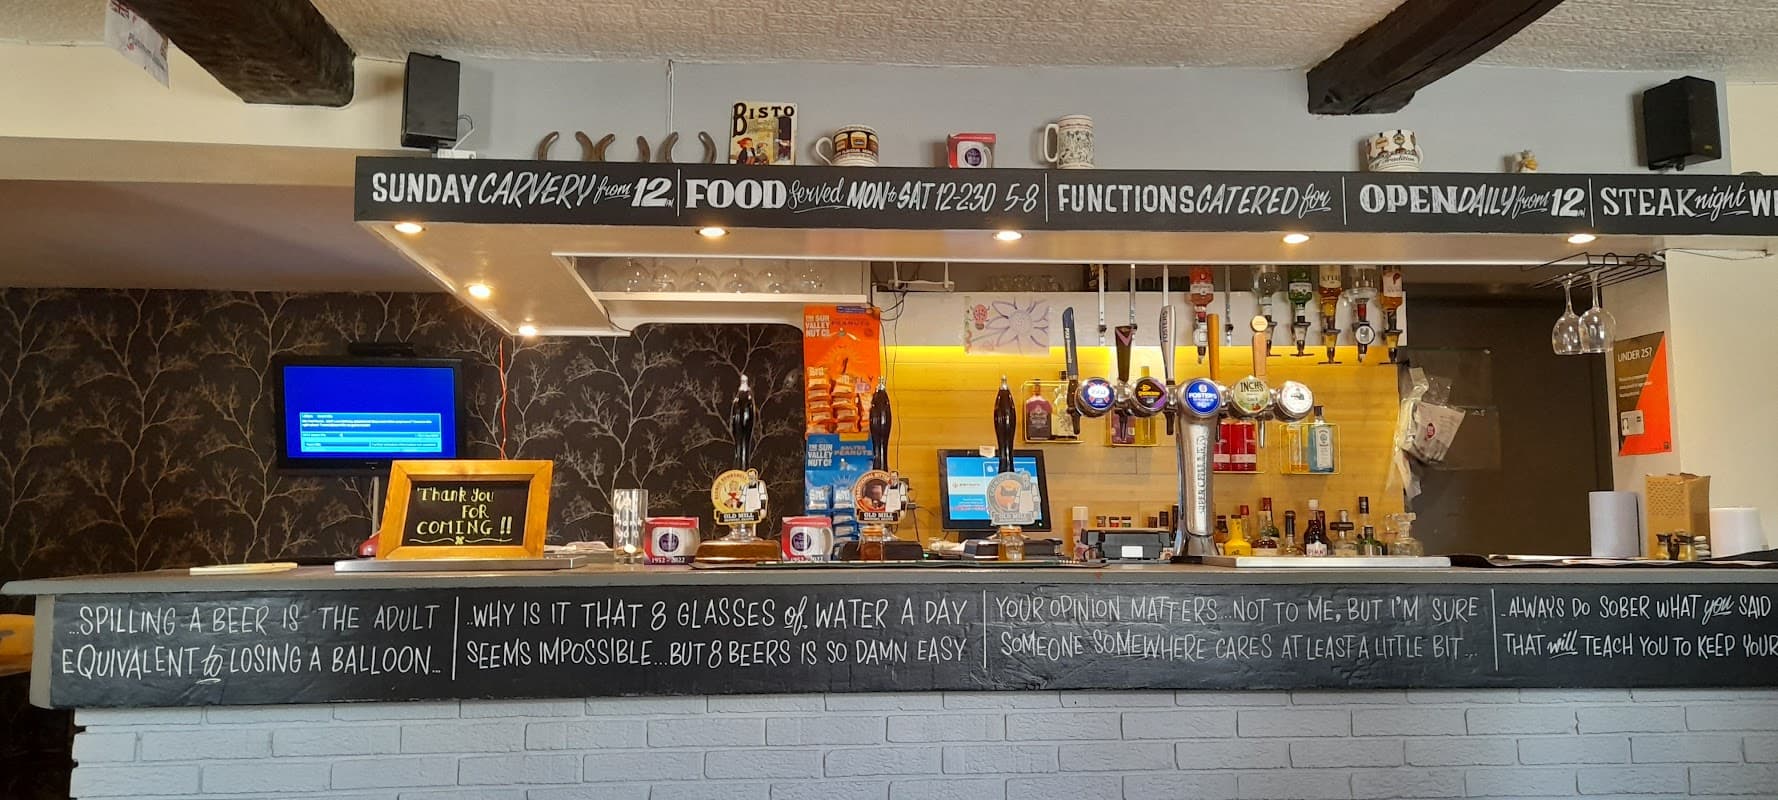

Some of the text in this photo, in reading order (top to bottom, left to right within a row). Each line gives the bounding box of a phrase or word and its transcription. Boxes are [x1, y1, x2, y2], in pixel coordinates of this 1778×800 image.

[732, 102, 795, 137] BISTO
[372, 172, 478, 204] SUNDAY
[476, 170, 597, 209] CARVERY
[592, 175, 632, 205] from
[631, 177, 672, 207] 12
[685, 178, 787, 210] FOOD
[846, 180, 889, 211] MON
[887, 187, 899, 204] to
[898, 181, 936, 210] SAT
[1004, 183, 1040, 213] 5-8
[1057, 183, 1332, 219] FUNCTIONS CATERED for
[1359, 184, 1459, 215] OPEN
[1457, 182, 1517, 217] DAILY
[1511, 185, 1551, 220] from
[1550, 187, 1585, 217] 12
[1600, 187, 1697, 218] STEAK
[1694, 181, 1750, 222] night
[1617, 350, 1640, 362] UNDER
[807, 451, 833, 459] VALLEY
[807, 459, 823, 467] NUT
[818, 443, 833, 451] SUN
[417, 487, 467, 503] Thank
[416, 516, 513, 535] COMING !!
[461, 504, 490, 520] FOR
[189, 606, 202, 633] A
[212, 606, 270, 636] BEER
[282, 604, 299, 632] IS
[319, 605, 360, 632] THE
[374, 604, 440, 634] ADULT
[523, 601, 541, 626] IS
[550, 601, 571, 626] IT
[582, 600, 643, 629] THAT
[650, 600, 667, 630] 8
[677, 598, 775, 629] GLASSES
[816, 598, 888, 630] WATER
[901, 600, 915, 626] A
[925, 599, 968, 628] DAY
[996, 596, 1045, 623] YOUR
[1050, 597, 1121, 623] OPINION
[1273, 601, 1299, 624] TO
[1308, 596, 1341, 624] ME,
[1347, 598, 1383, 622] BUT
[1391, 596, 1419, 621] I'M
[1432, 597, 1479, 623] SURE
[1572, 597, 1591, 618] DO
[1599, 595, 1651, 620] SOBER
[1656, 594, 1703, 619] WHAT
[1702, 594, 1735, 625] you
[1738, 594, 1771, 619] SAID
[466, 639, 532, 668] SEEMS
[707, 638, 722, 669] 8
[728, 638, 791, 667] BEERS
[801, 638, 817, 666] IS
[827, 641, 848, 663] SO
[856, 639, 907, 664] DAMN
[917, 637, 967, 664] EASY
[1000, 633, 1083, 662] SOMEONE
[1093, 632, 1207, 662] SOMEWHERE
[1216, 633, 1272, 660] CARES
[1281, 634, 1304, 660] AT
[1307, 634, 1357, 661] LEAST
[1358, 635, 1370, 659] A
[1375, 634, 1424, 659] LITTLE
[1502, 628, 1778, 660] THAT will TEACH YOU TO KEEP YOUR
[62, 644, 201, 681] EQUIVALENT
[196, 645, 223, 684] to
[230, 643, 301, 674] LOSING
[308, 644, 323, 672] A
